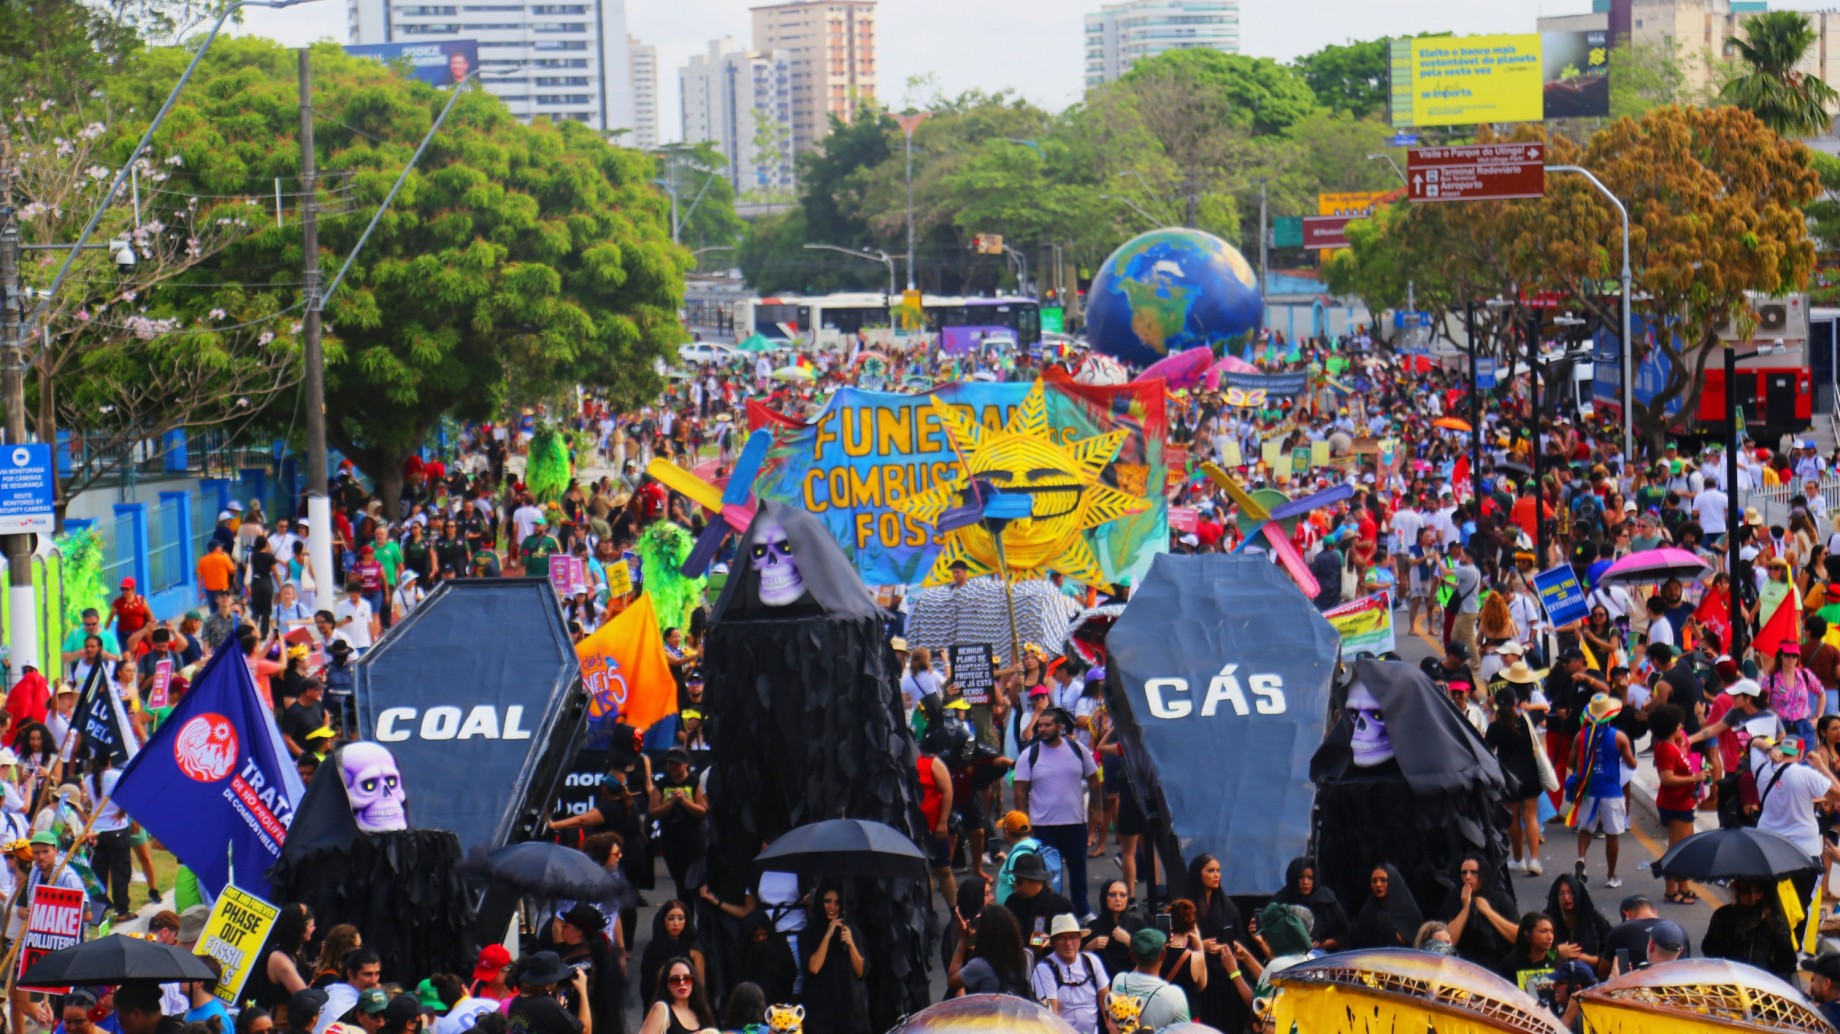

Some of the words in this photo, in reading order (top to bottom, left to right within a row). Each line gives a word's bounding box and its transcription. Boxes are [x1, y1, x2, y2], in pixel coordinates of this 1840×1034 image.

[1419, 48, 1450, 58] Eleito
[1460, 47, 1490, 57] banco
[1493, 45, 1516, 54] mais
[1420, 57, 1479, 67] sustentável
[1482, 56, 1495, 64] do
[1497, 54, 1536, 66] planeta
[1420, 67, 1442, 79] pela
[1445, 66, 1472, 77] sexta
[1474, 67, 1491, 75] vez
[1419, 150, 1441, 159] Visite
[1450, 148, 1480, 158] Parque
[1482, 147, 1493, 156] do
[1440, 167, 1475, 176] Terminal
[1477, 165, 1522, 175] Rodoviário
[1440, 180, 1483, 191] Aeroporto
[8, 467, 44, 475] MONITORADA
[24, 505, 50, 513] CAMERAS
[1547, 594, 1583, 614] EXTINCTION
[957, 646, 984, 655] NENHUM
[956, 655, 977, 664] PLANO
[977, 654, 986, 662] DE
[954, 671, 984, 680] PROTEGE
[953, 680, 967, 688] QUE
[967, 677, 976, 688] JÁ
[976, 677, 993, 687] ESTÁ
[962, 688, 984, 696] SENDO
[1144, 663, 1287, 719] GÁS
[375, 704, 531, 742] COAL
[232, 778, 244, 792] DE
[241, 790, 257, 806] NO
[241, 757, 294, 831] TRATA
[222, 788, 235, 802] DE
[232, 799, 279, 856] COMBUSTIBLES
[29, 904, 80, 936] MAKE
[221, 901, 262, 934] PHASE
[26, 932, 76, 950] POLLUTERS
[219, 922, 247, 947] OUT
[202, 935, 245, 970] FOSSIL
